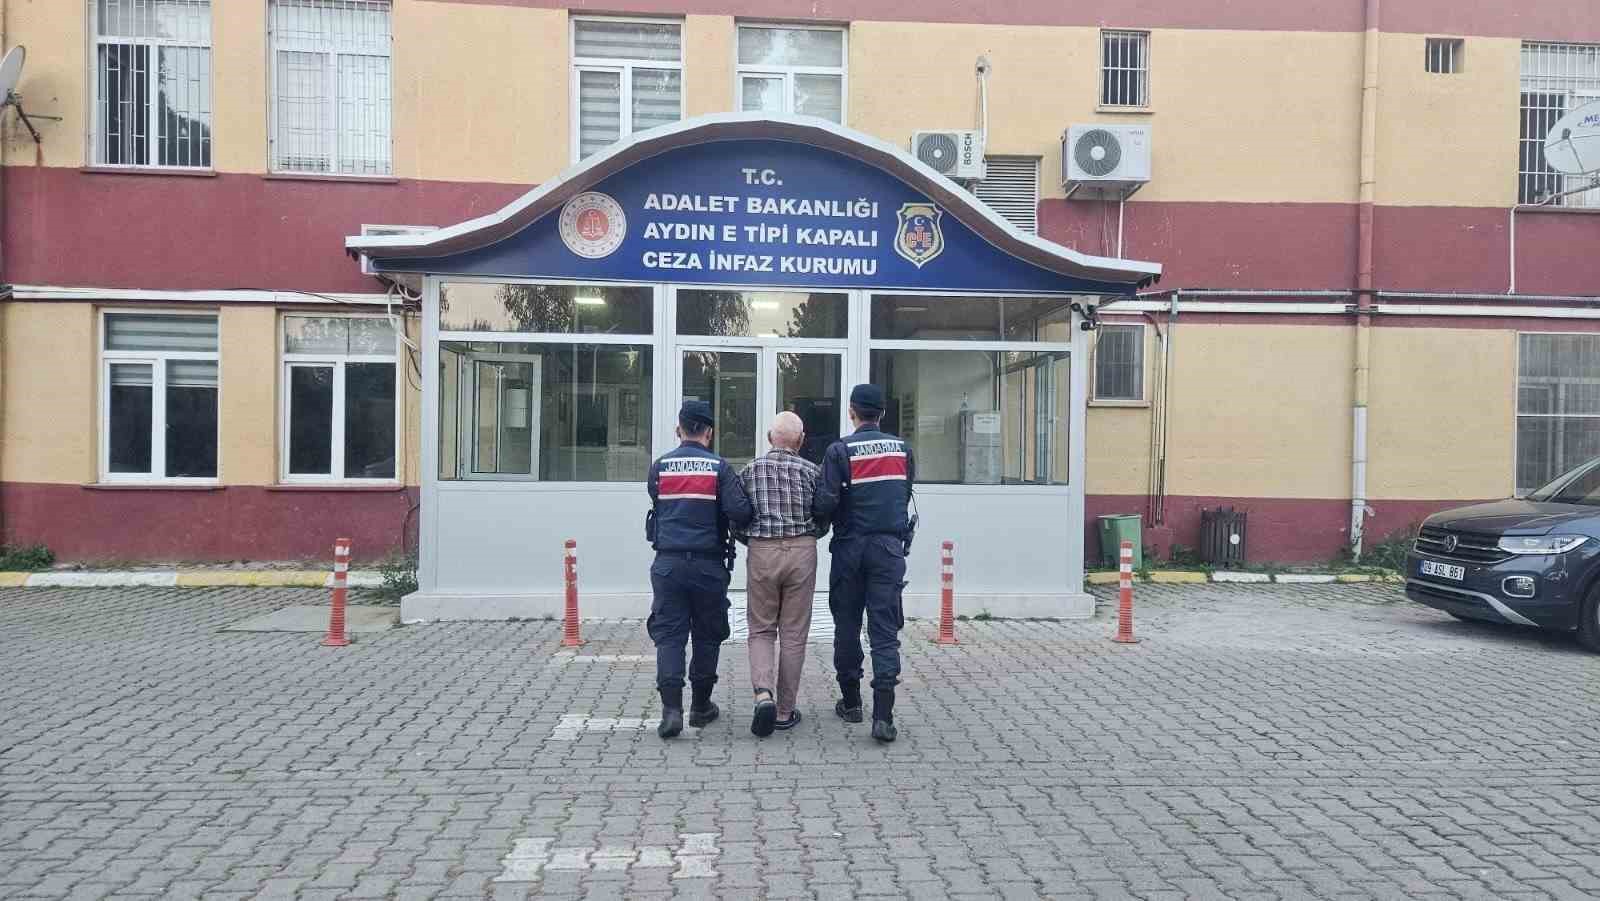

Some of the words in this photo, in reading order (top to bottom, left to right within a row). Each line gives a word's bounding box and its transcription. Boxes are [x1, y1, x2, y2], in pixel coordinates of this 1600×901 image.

[963, 133, 972, 165] BOSCH
[741, 168, 783, 186] T.C.
[643, 193, 739, 213] ADALET
[747, 197, 878, 218] BAKANLIĞI
[643, 222, 715, 241] AYDIN
[723, 225, 737, 242] E
[744, 222, 788, 243] TİPİ
[796, 228, 878, 247] KAPALI
[642, 251, 703, 270] CEZA
[709, 249, 774, 272] İNFAZ
[780, 256, 877, 275] KURUMU
[855, 442, 902, 456] JANDARMA
[665, 460, 713, 472] JANDARMA
